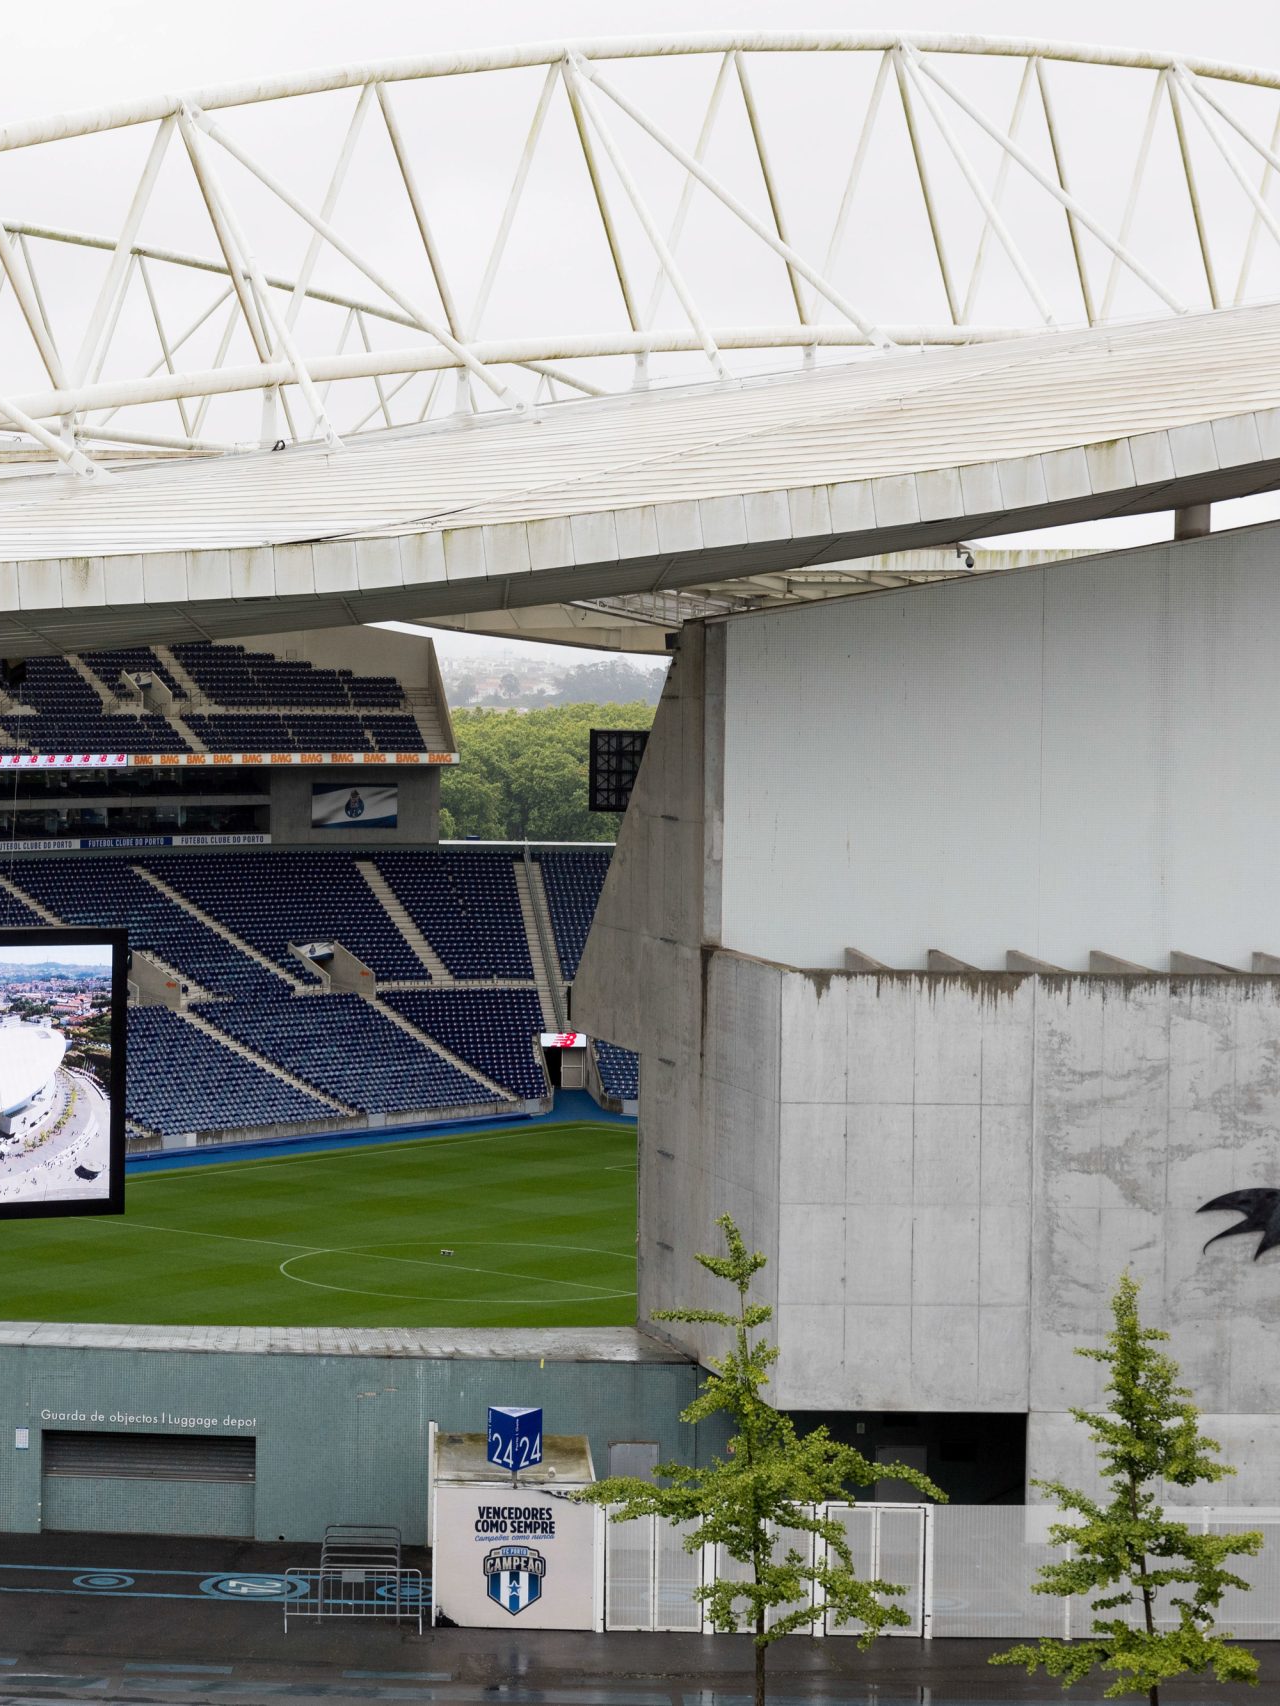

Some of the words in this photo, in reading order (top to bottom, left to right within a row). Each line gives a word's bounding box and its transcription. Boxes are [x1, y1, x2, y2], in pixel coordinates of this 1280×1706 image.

[134, 756, 153, 764] BMG
[161, 755, 179, 764] BMG
[187, 755, 206, 764] BMG
[214, 755, 233, 763] BMG
[242, 754, 262, 763] BMG
[271, 754, 292, 763] BMG
[301, 753, 322, 762] BMG
[332, 753, 354, 762] BMG
[364, 753, 386, 762] BMG
[396, 753, 419, 762] BMG
[429, 753, 452, 762] BMG
[135, 838, 143, 846] DO
[41, 1409, 86, 1421] Guarda
[90, 1410, 105, 1422] de
[109, 1412, 158, 1425] objectos
[168, 1413, 218, 1428] Luggage
[223, 1415, 257, 1429] depot
[492, 1432, 514, 1468] 24
[519, 1432, 541, 1468] 24
[477, 1506, 553, 1520] VENCEDORES
[474, 1519, 508, 1533] COMO
[510, 1520, 556, 1534] SEMPRE
